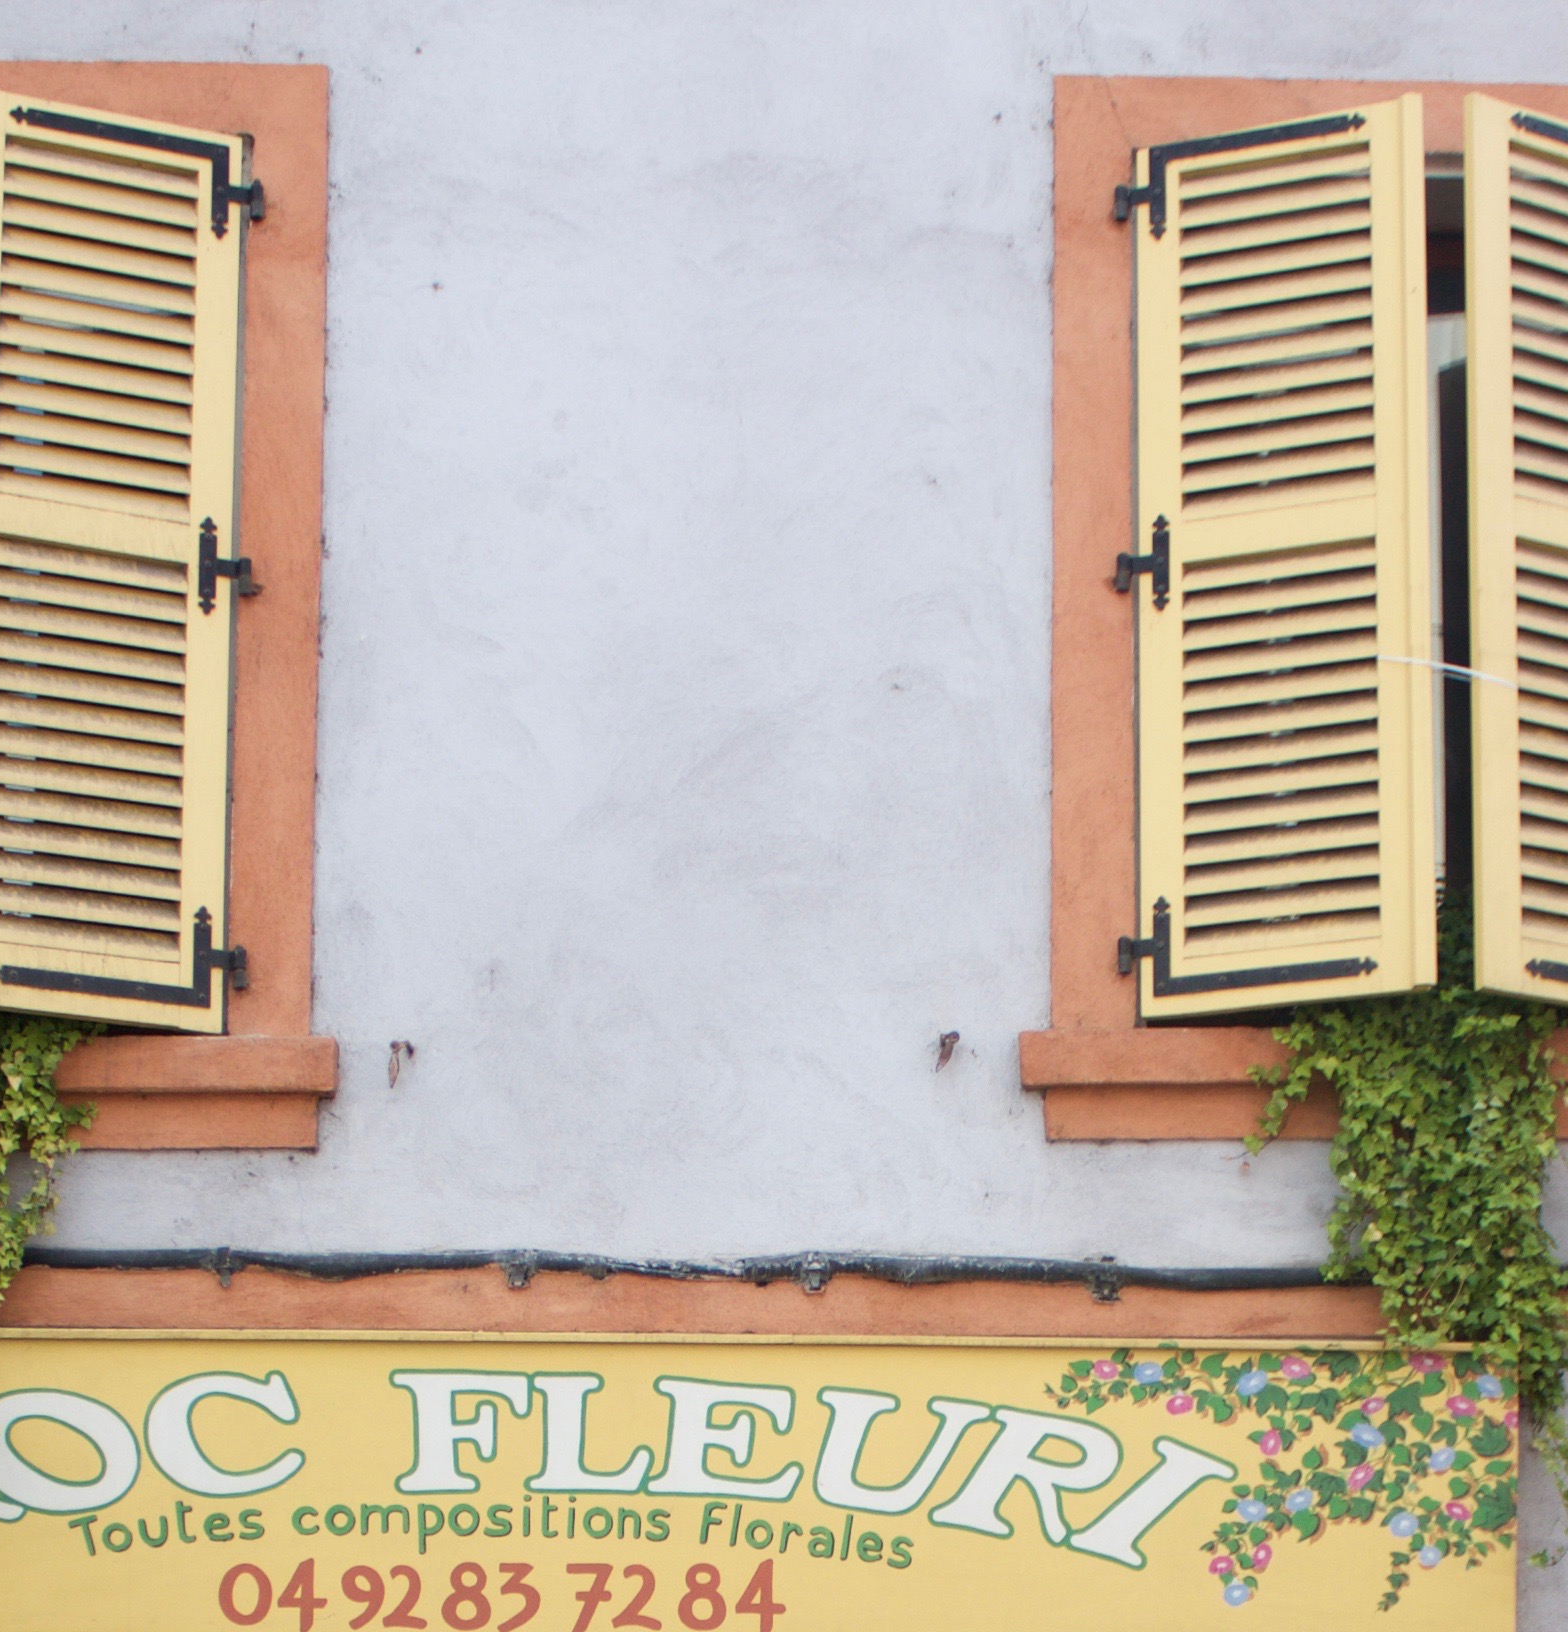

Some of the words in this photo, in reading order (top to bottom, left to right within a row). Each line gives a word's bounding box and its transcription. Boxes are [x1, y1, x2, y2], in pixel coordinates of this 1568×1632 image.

[68, 1500, 266, 1557] Toutes
[291, 1494, 671, 1555] compositions
[389, 1366, 1239, 1572] FLEURI
